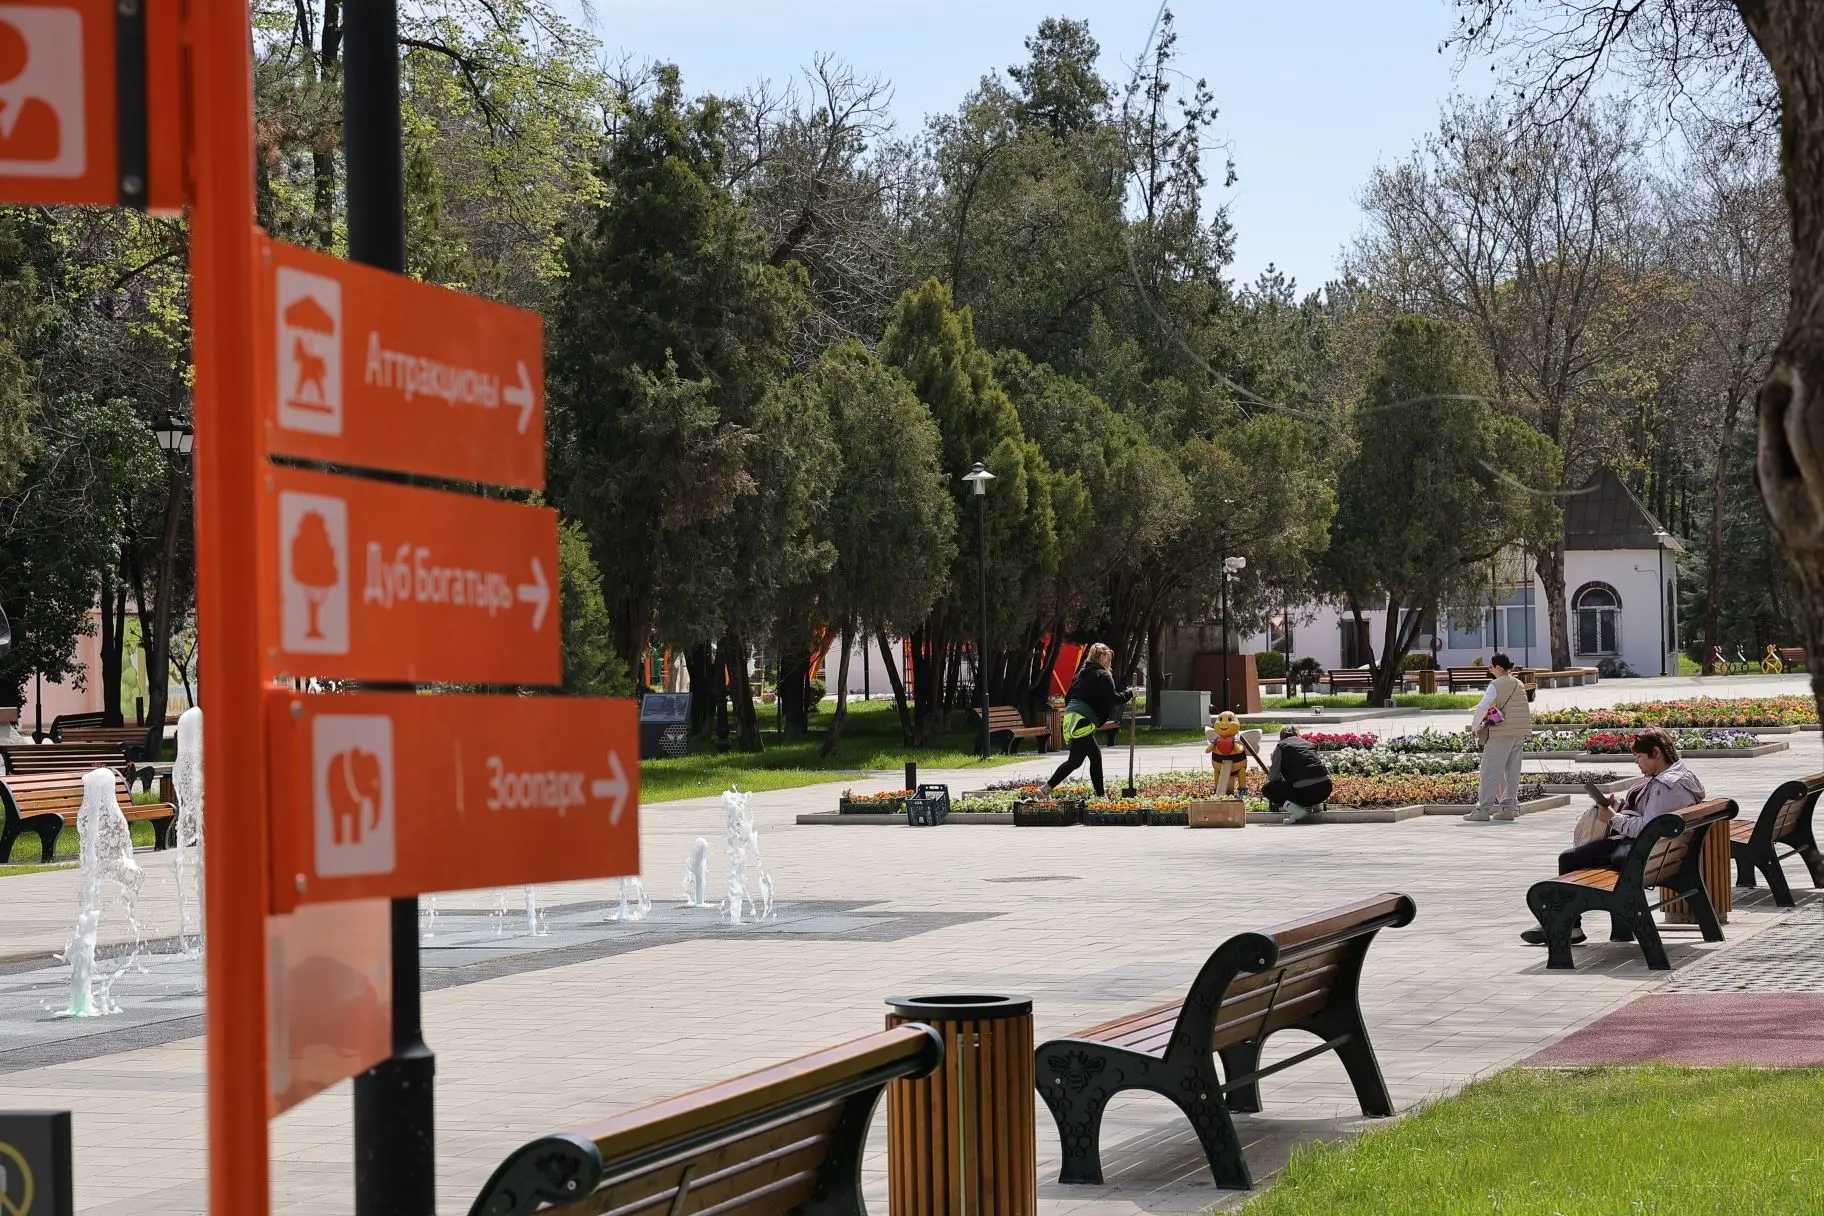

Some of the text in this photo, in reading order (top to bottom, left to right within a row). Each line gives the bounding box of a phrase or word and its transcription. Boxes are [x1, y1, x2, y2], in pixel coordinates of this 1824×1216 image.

[364, 330, 500, 408] Аттракционы
[363, 541, 513, 618] Дуб Богатырь
[486, 755, 586, 818] Зоопарк
